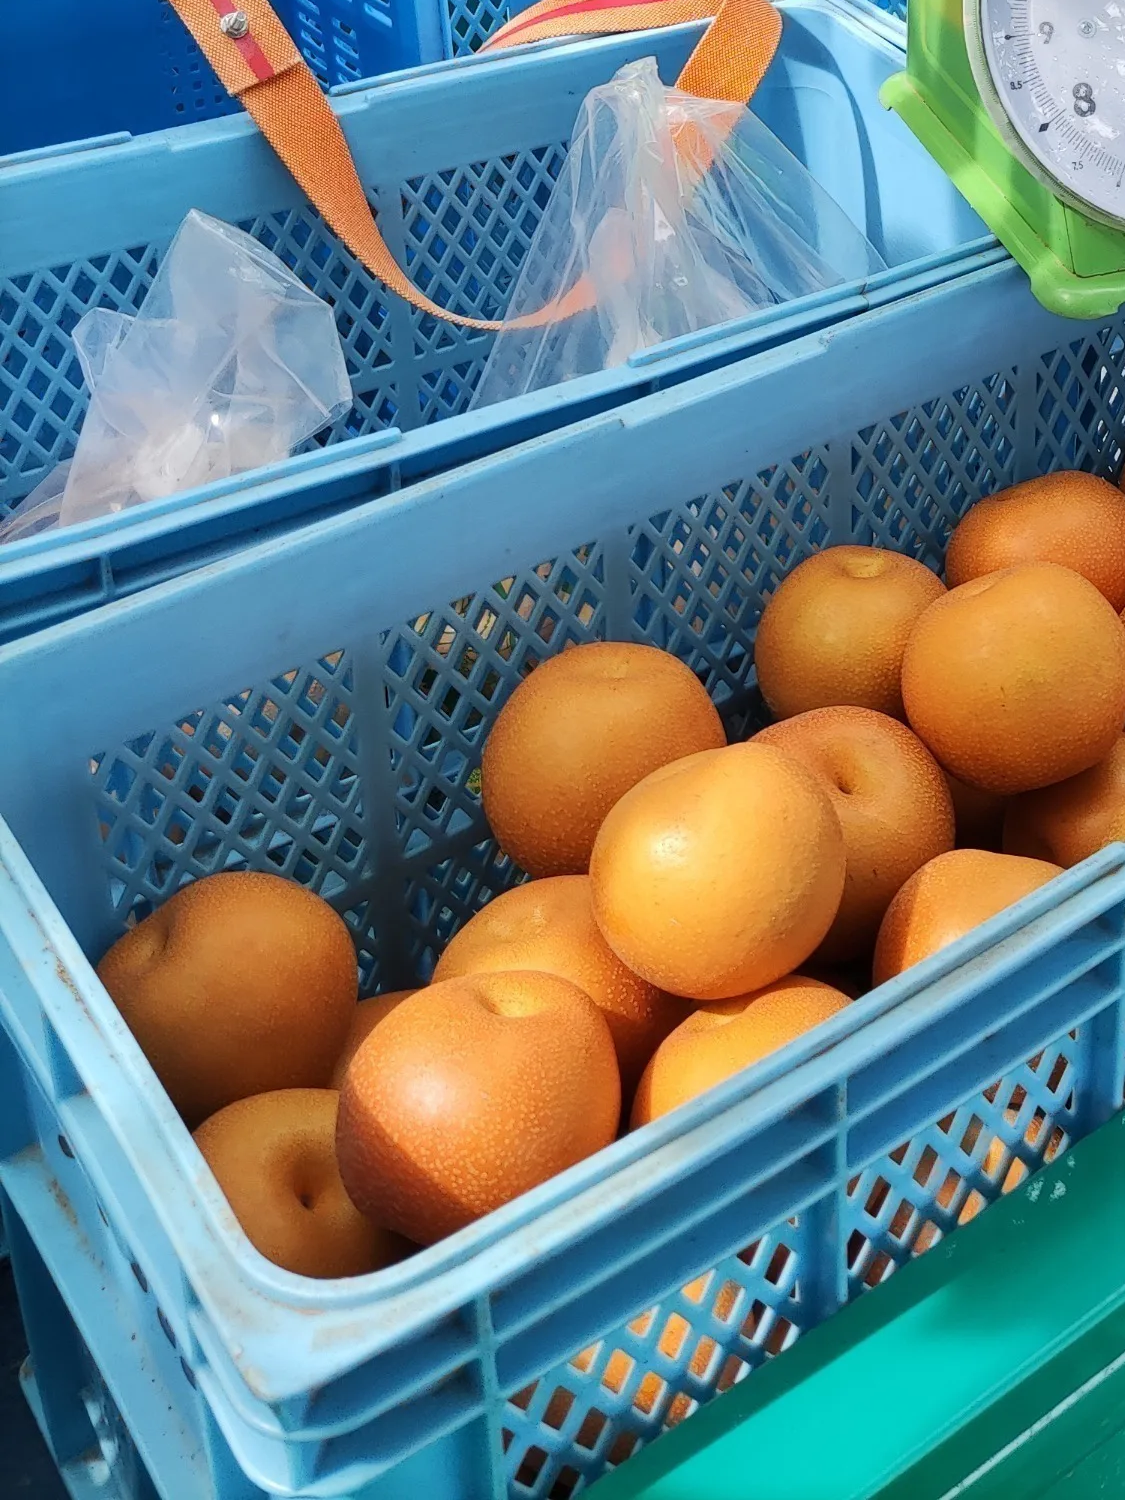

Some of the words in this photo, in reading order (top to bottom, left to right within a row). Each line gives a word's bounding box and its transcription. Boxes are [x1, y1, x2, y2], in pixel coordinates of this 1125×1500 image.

[1039, 21, 1054, 44] 9
[1010, 81, 1023, 90] 8.5
[1072, 82, 1097, 118] 8
[1071, 161, 1084, 171] 7.5
